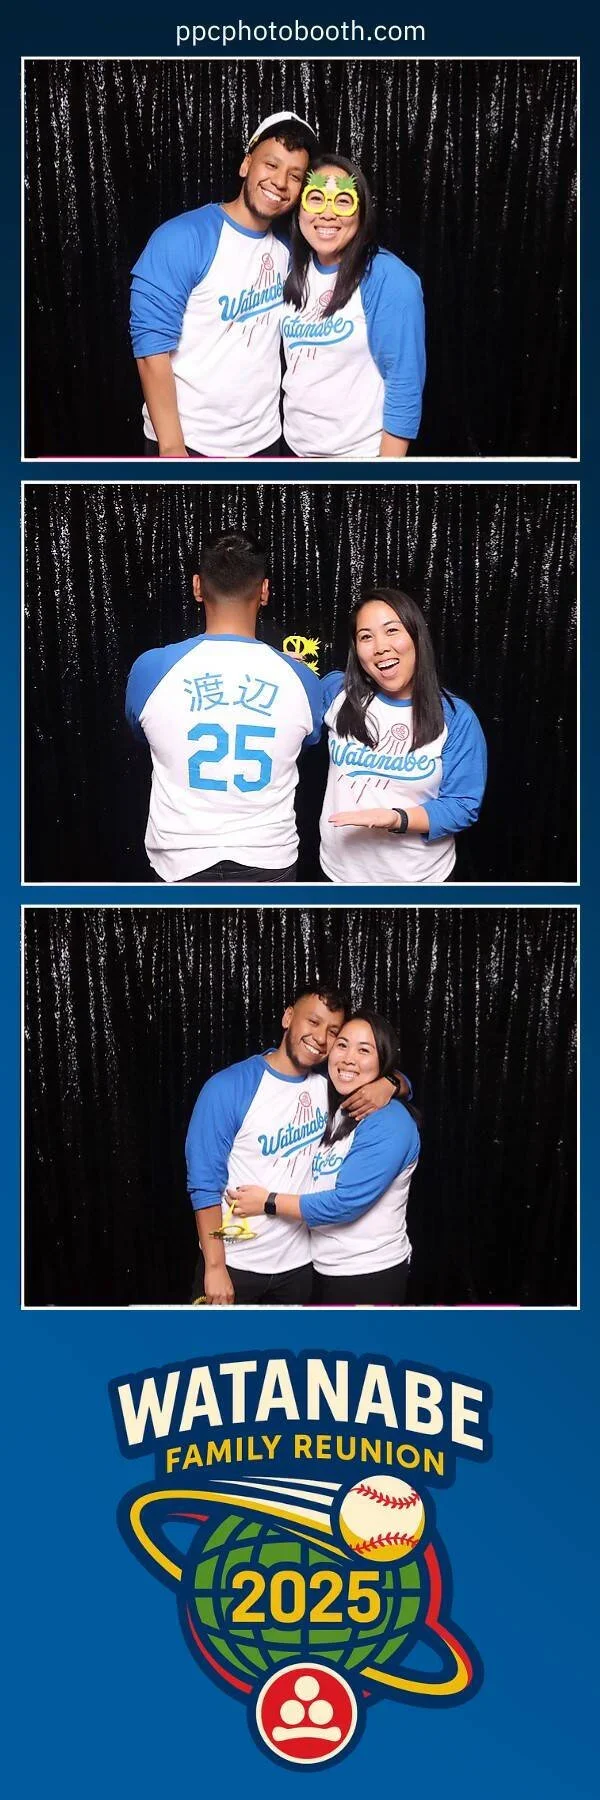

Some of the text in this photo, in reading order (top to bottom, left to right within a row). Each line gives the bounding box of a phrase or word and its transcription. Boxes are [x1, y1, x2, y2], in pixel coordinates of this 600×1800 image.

[218, 272, 285, 322] Watanab
[183, 672, 279, 717] 渡辺
[187, 723, 276, 793] 25
[330, 739, 433, 775] Watanabe
